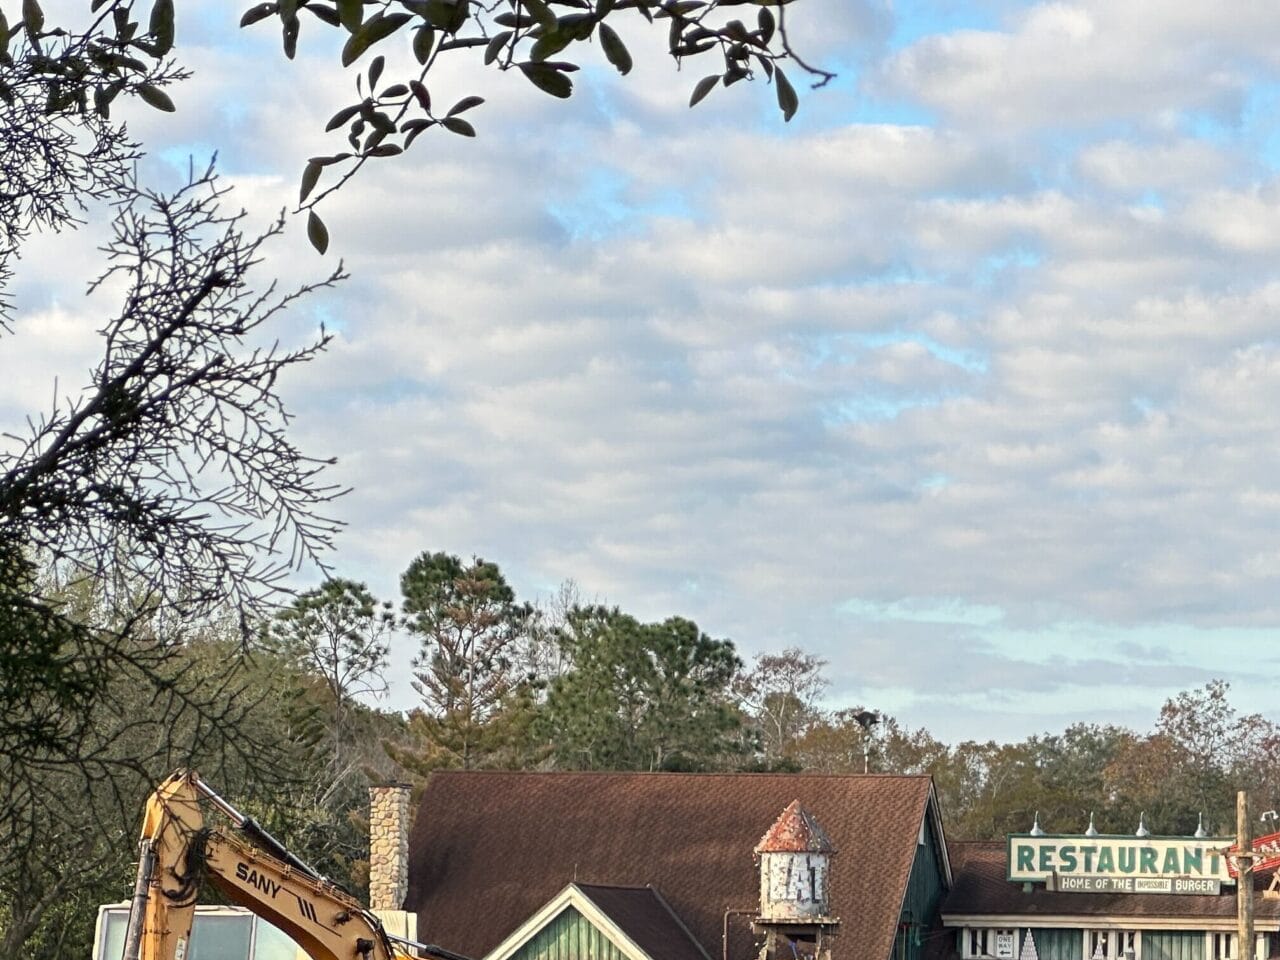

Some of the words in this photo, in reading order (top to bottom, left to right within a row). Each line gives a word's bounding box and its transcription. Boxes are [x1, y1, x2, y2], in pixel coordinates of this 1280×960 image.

[1017, 845, 1220, 875] RESTAURANT
[235, 861, 282, 899] SANY
[768, 855, 826, 904] EAT
[1062, 878, 1092, 889] HOME
[1095, 878, 1108, 889] OF
[1111, 879, 1133, 890] THE
[1175, 880, 1214, 892] BURGER
[999, 935, 1013, 943] ONE
